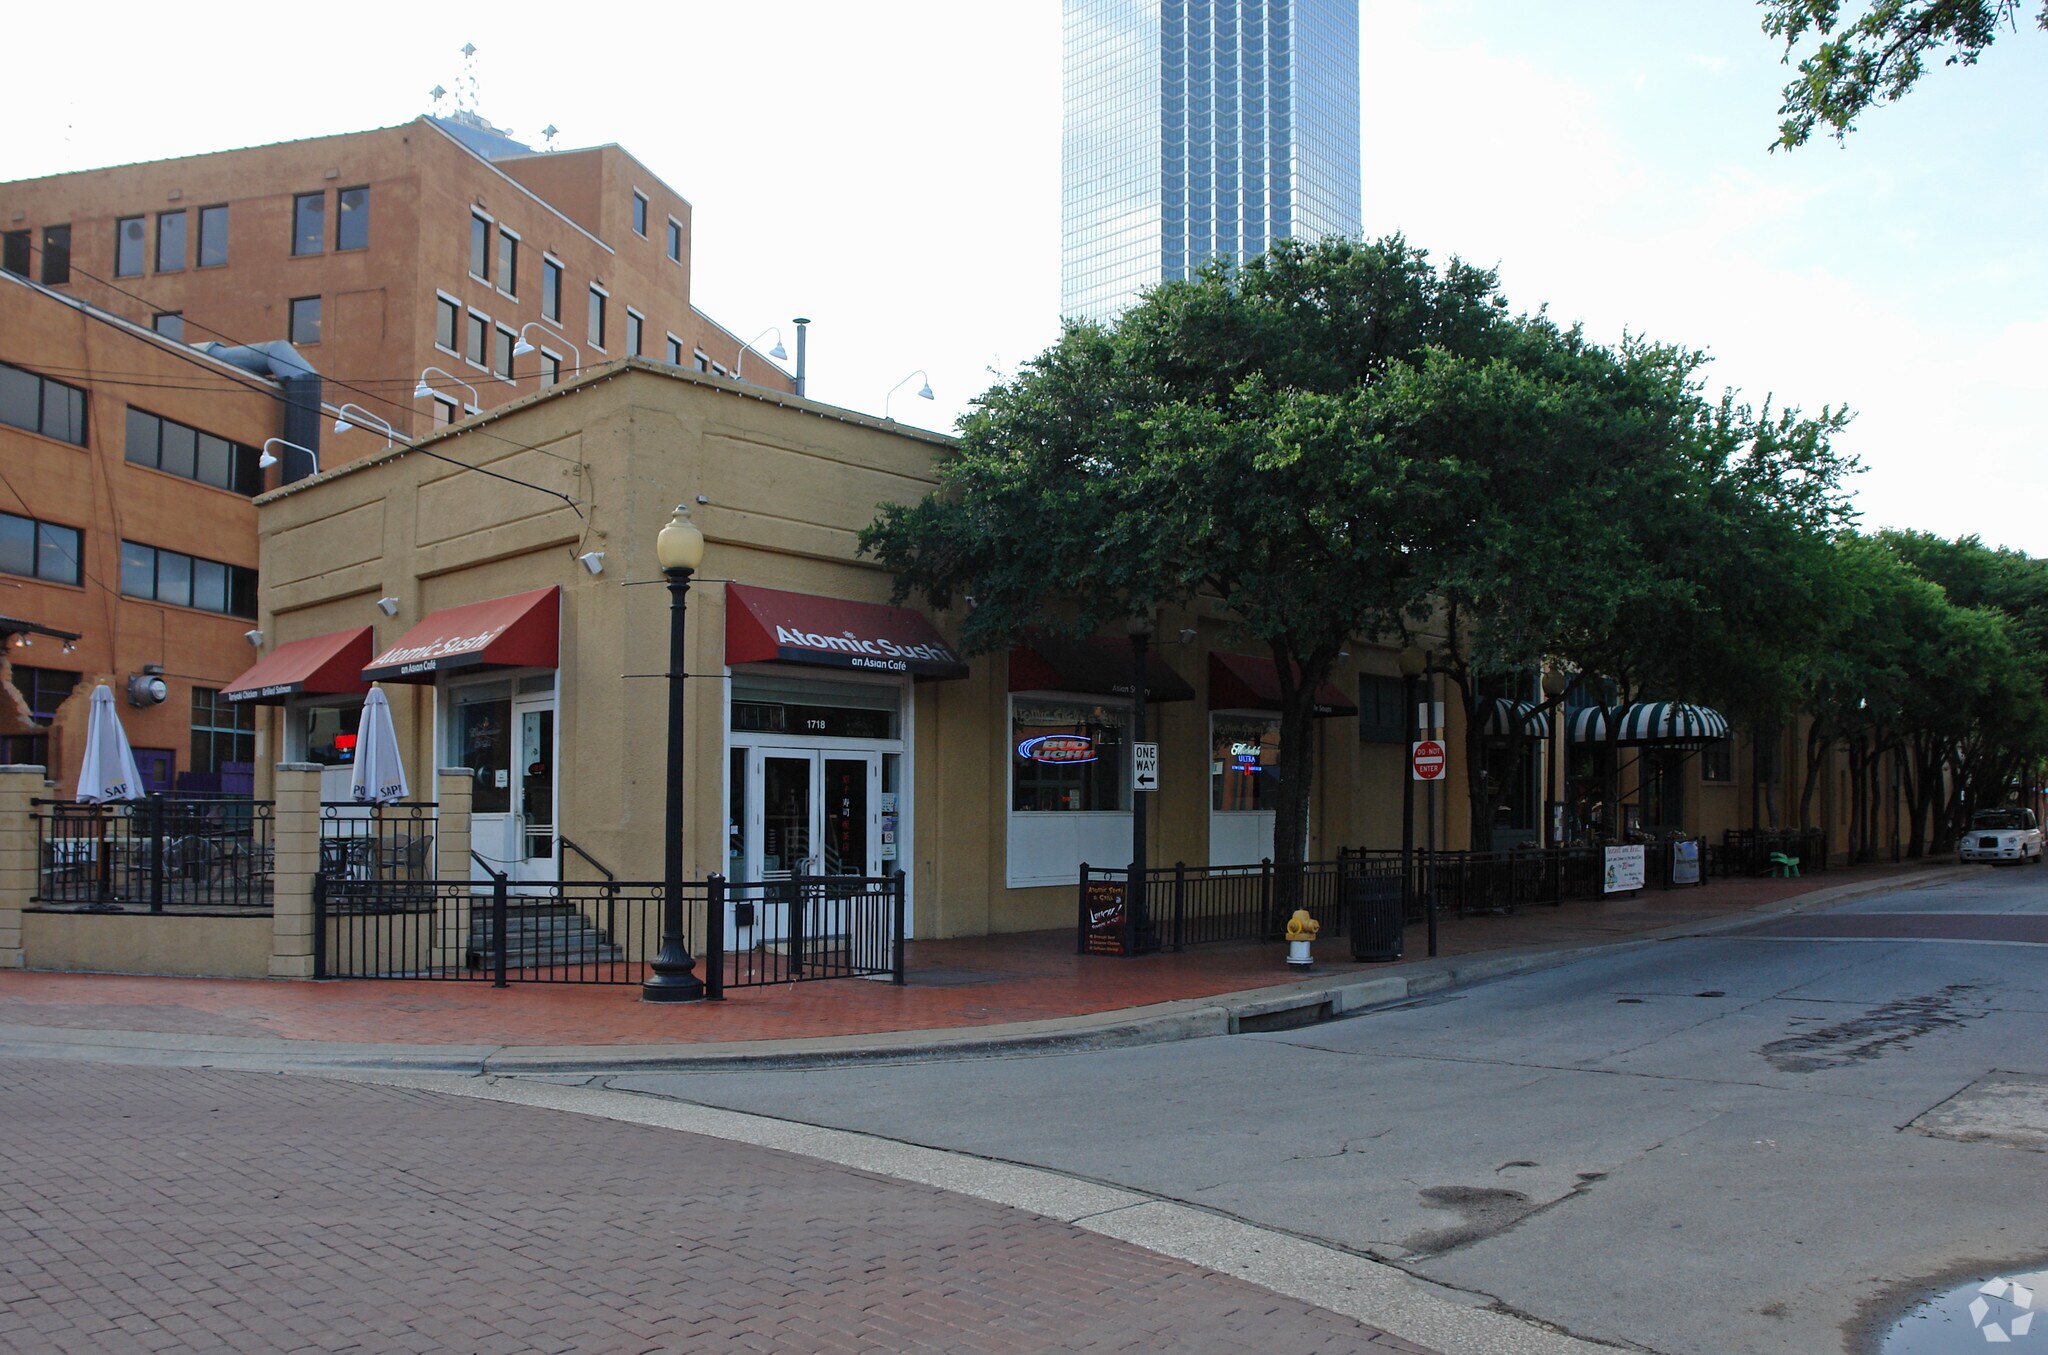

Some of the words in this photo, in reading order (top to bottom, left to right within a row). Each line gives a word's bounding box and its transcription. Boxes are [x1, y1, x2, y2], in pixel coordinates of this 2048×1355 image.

[370, 639, 442, 666] Atomic
[440, 629, 496, 653] Sushi
[776, 624, 881, 655] Atomic
[876, 638, 956, 662] Sushi
[401, 666, 409, 675] an
[409, 663, 423, 673] Asian
[423, 660, 437, 670] Café
[852, 657, 863, 666] an
[864, 657, 887, 669] Asian
[888, 659, 907, 671] Café
[1112, 684, 1129, 693] Asian
[242, 691, 258, 699] Chicken
[806, 720, 826, 730] 1718
[1042, 740, 1091, 751] BUD
[1031, 750, 1096, 761] LIGHT
[1136, 747, 1155, 758] ONE
[1238, 755, 1256, 763] ULTRA
[1136, 760, 1155, 771] WAY
